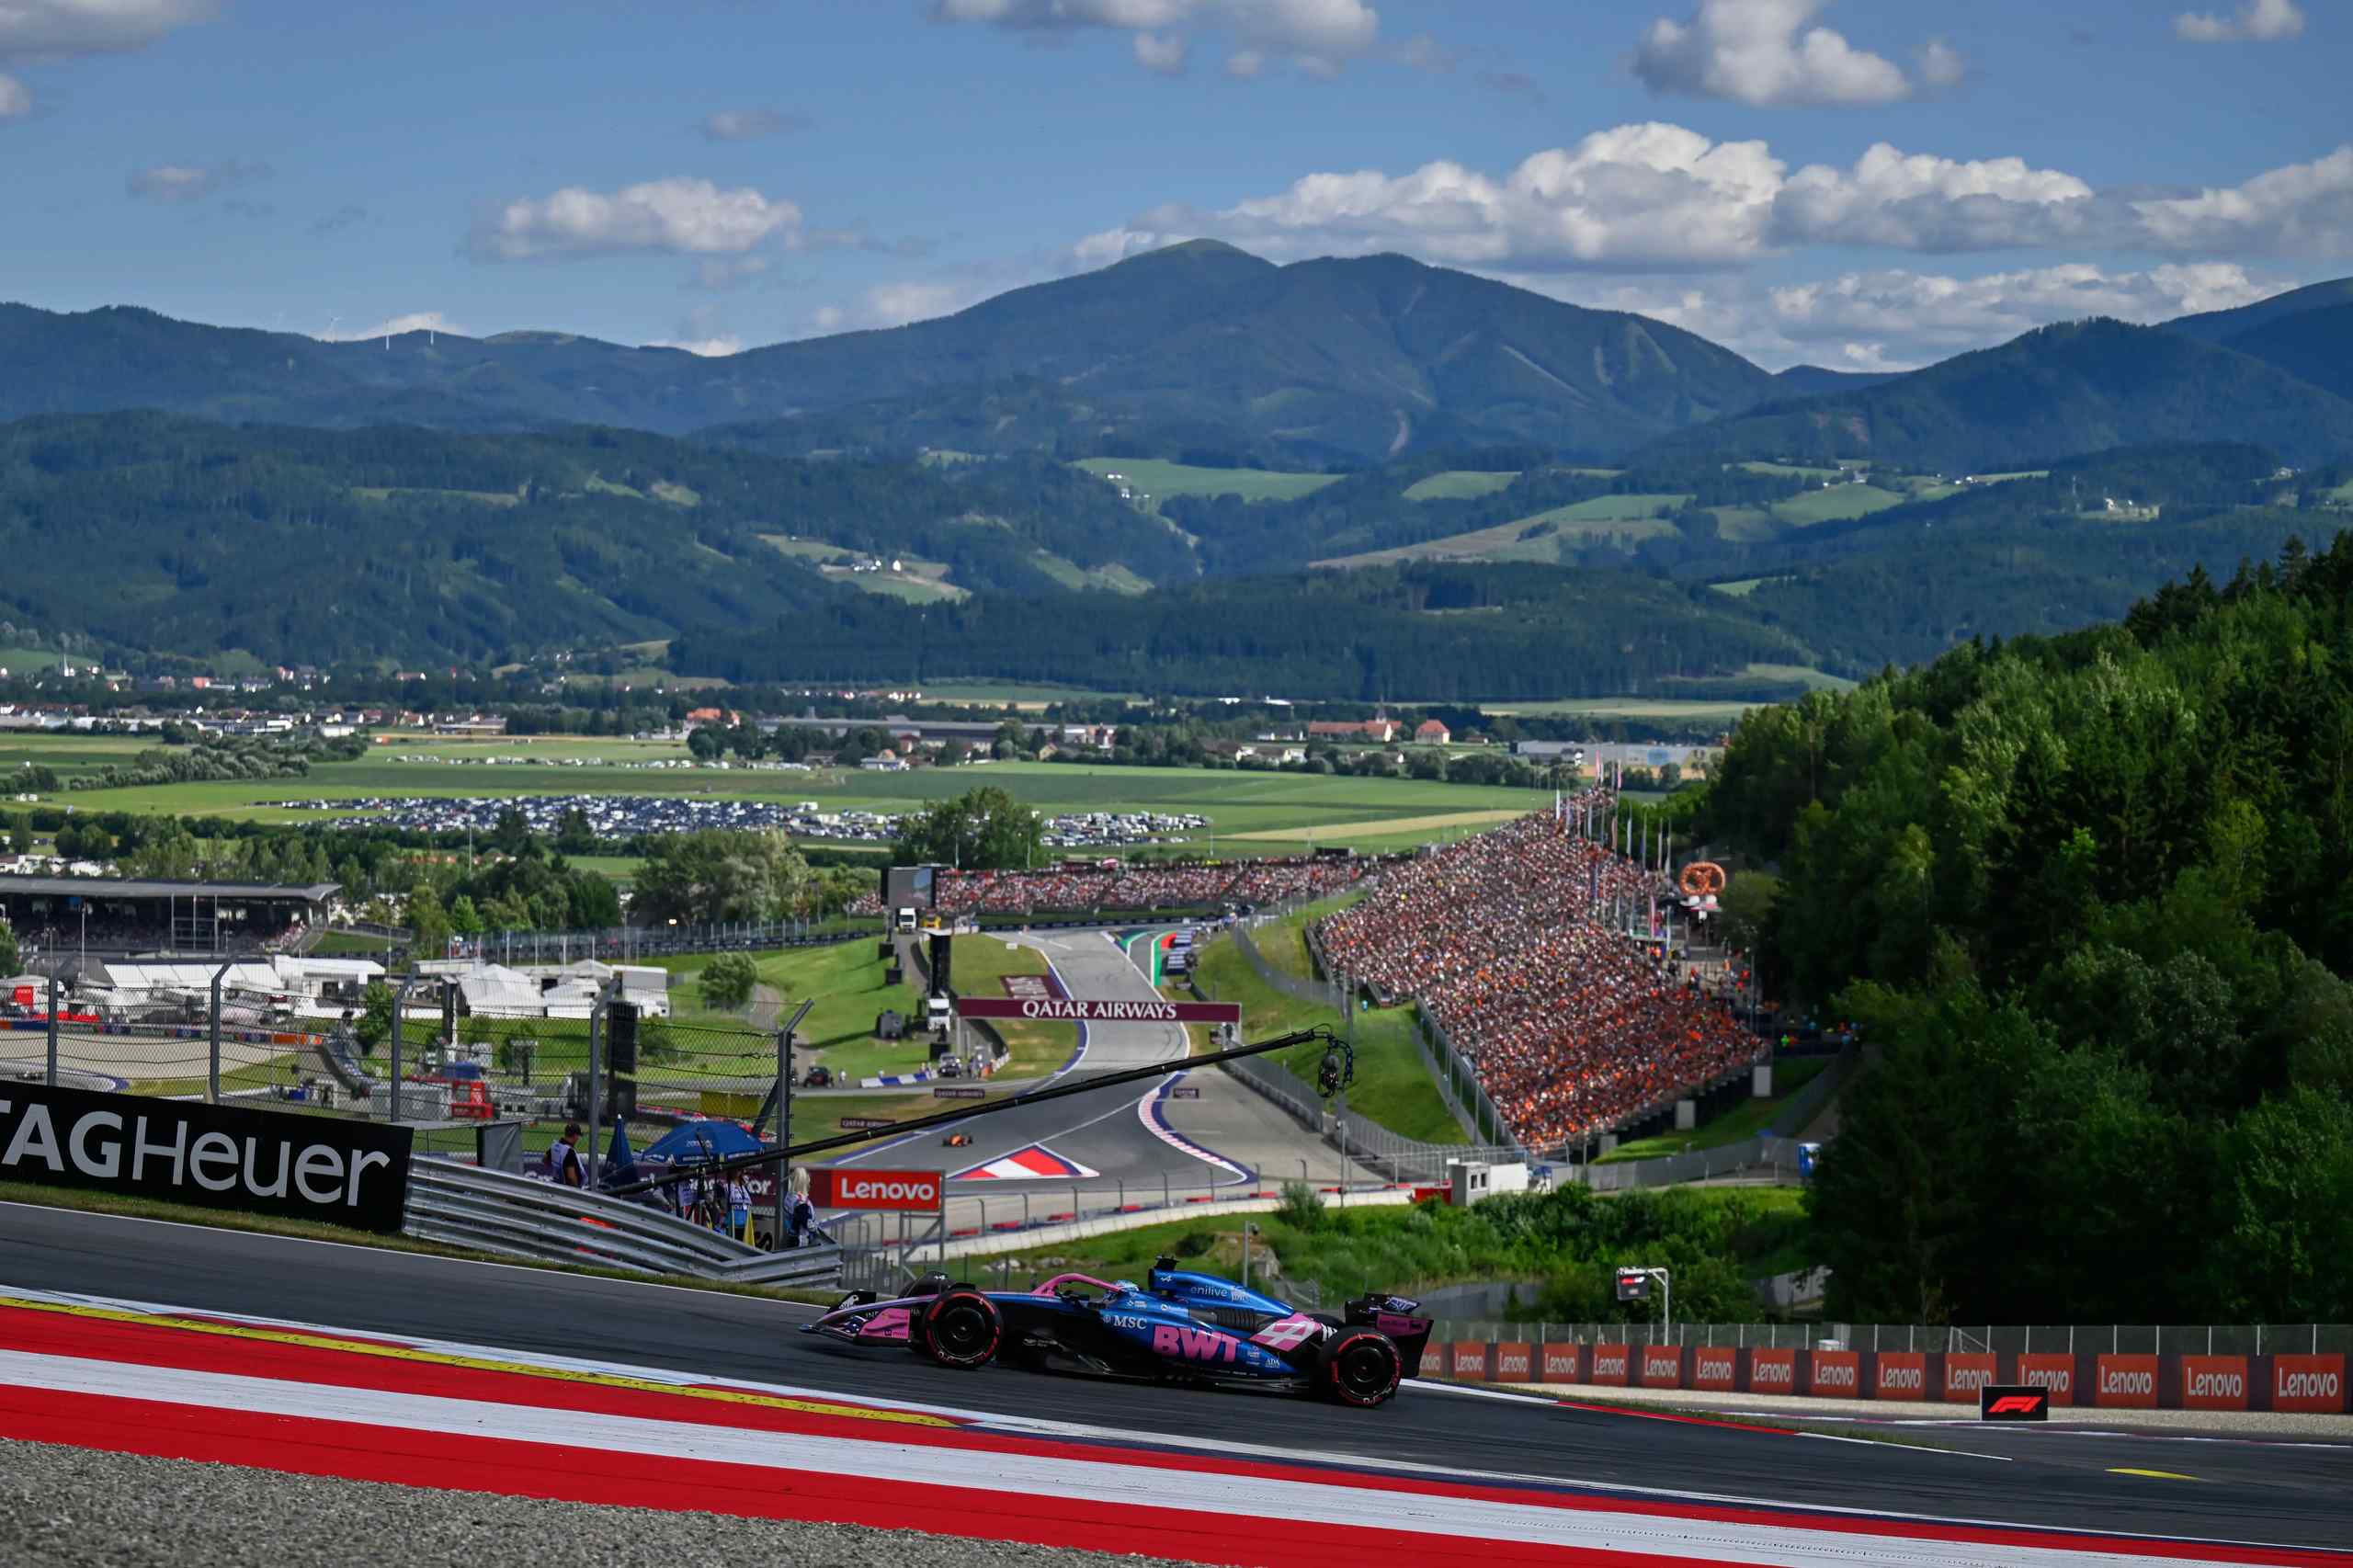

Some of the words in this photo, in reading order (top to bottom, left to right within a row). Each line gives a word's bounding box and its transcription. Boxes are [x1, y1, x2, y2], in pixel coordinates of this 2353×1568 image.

[1022, 1000, 1088, 1019] QATAR
[1094, 1001, 1177, 1020] AIRWAYS
[0, 1099, 123, 1178] AG
[133, 1116, 391, 1207] Heuer
[841, 1176, 935, 1200] Lenovo
[1190, 1285, 1228, 1298] enilive
[1114, 1314, 1147, 1329] MSC
[1153, 1324, 1240, 1361] BWT
[1498, 1351, 1528, 1373] Lenovo
[1545, 1352, 1575, 1374] Lenovo
[1594, 1353, 1625, 1376] Lenovo
[1644, 1354, 1677, 1378] Lenovo
[1697, 1356, 1732, 1381] Lenovo
[1753, 1358, 1790, 1382] Lenovo
[1815, 1360, 1854, 1385] Lenovo
[1881, 1363, 1921, 1388] Lenovo
[1948, 1364, 1992, 1391] Lenovo
[2100, 1366, 2152, 1394] Lenovo
[2188, 1367, 2242, 1397] Lenovo
[2278, 1367, 2338, 1397] Lenovo
